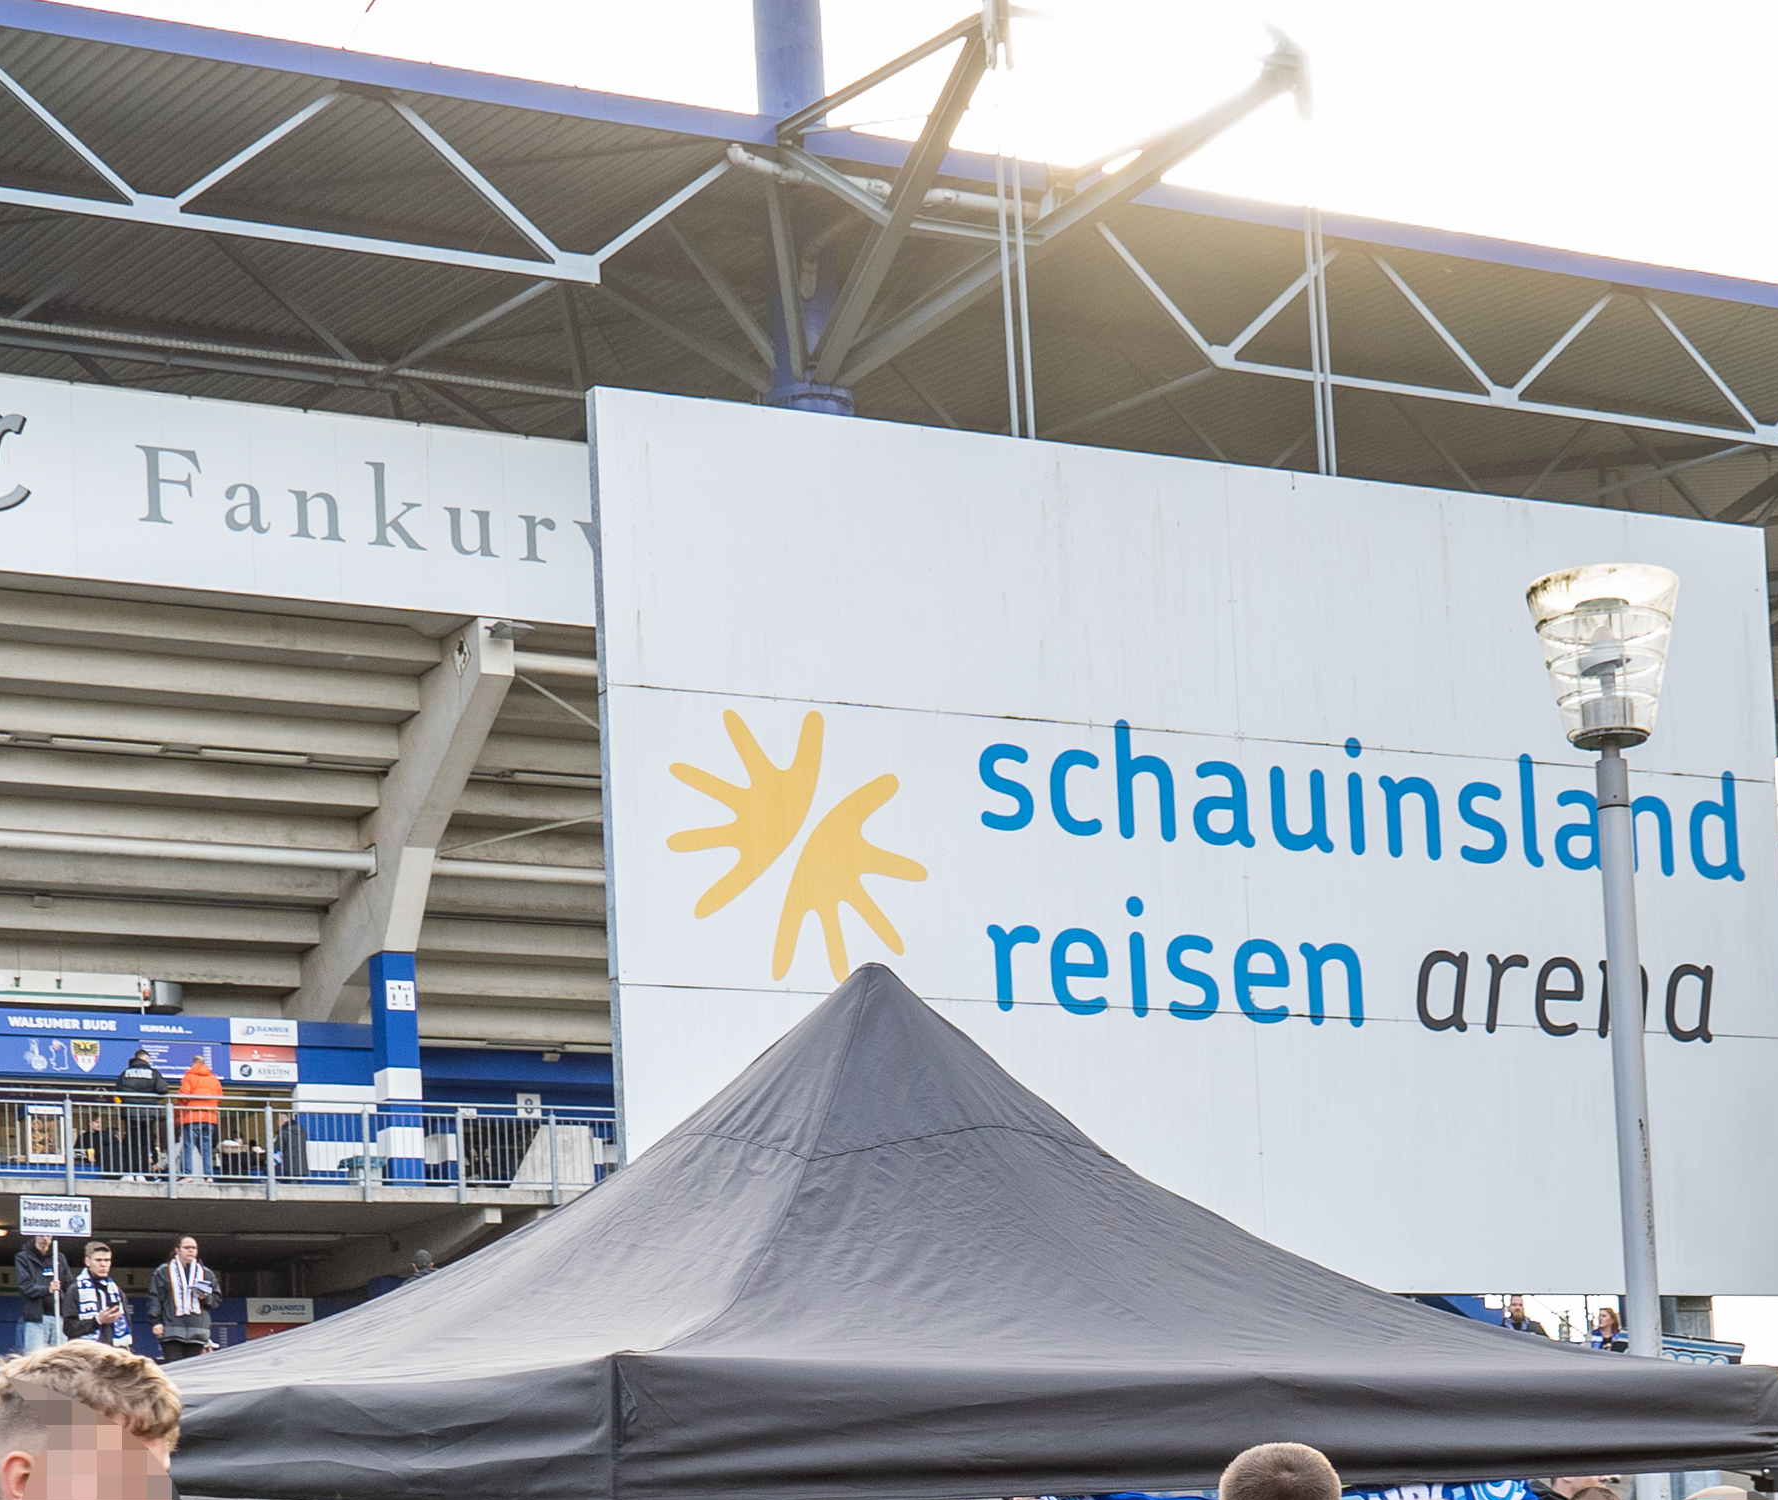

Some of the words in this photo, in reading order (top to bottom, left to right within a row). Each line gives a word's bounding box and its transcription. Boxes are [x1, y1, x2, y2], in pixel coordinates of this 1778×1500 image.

[978, 718, 1747, 884] schauinsland
[7, 1016, 81, 1030] WALSUMER
[83, 1019, 117, 1032] BUDE
[986, 895, 1365, 1028] reisen
